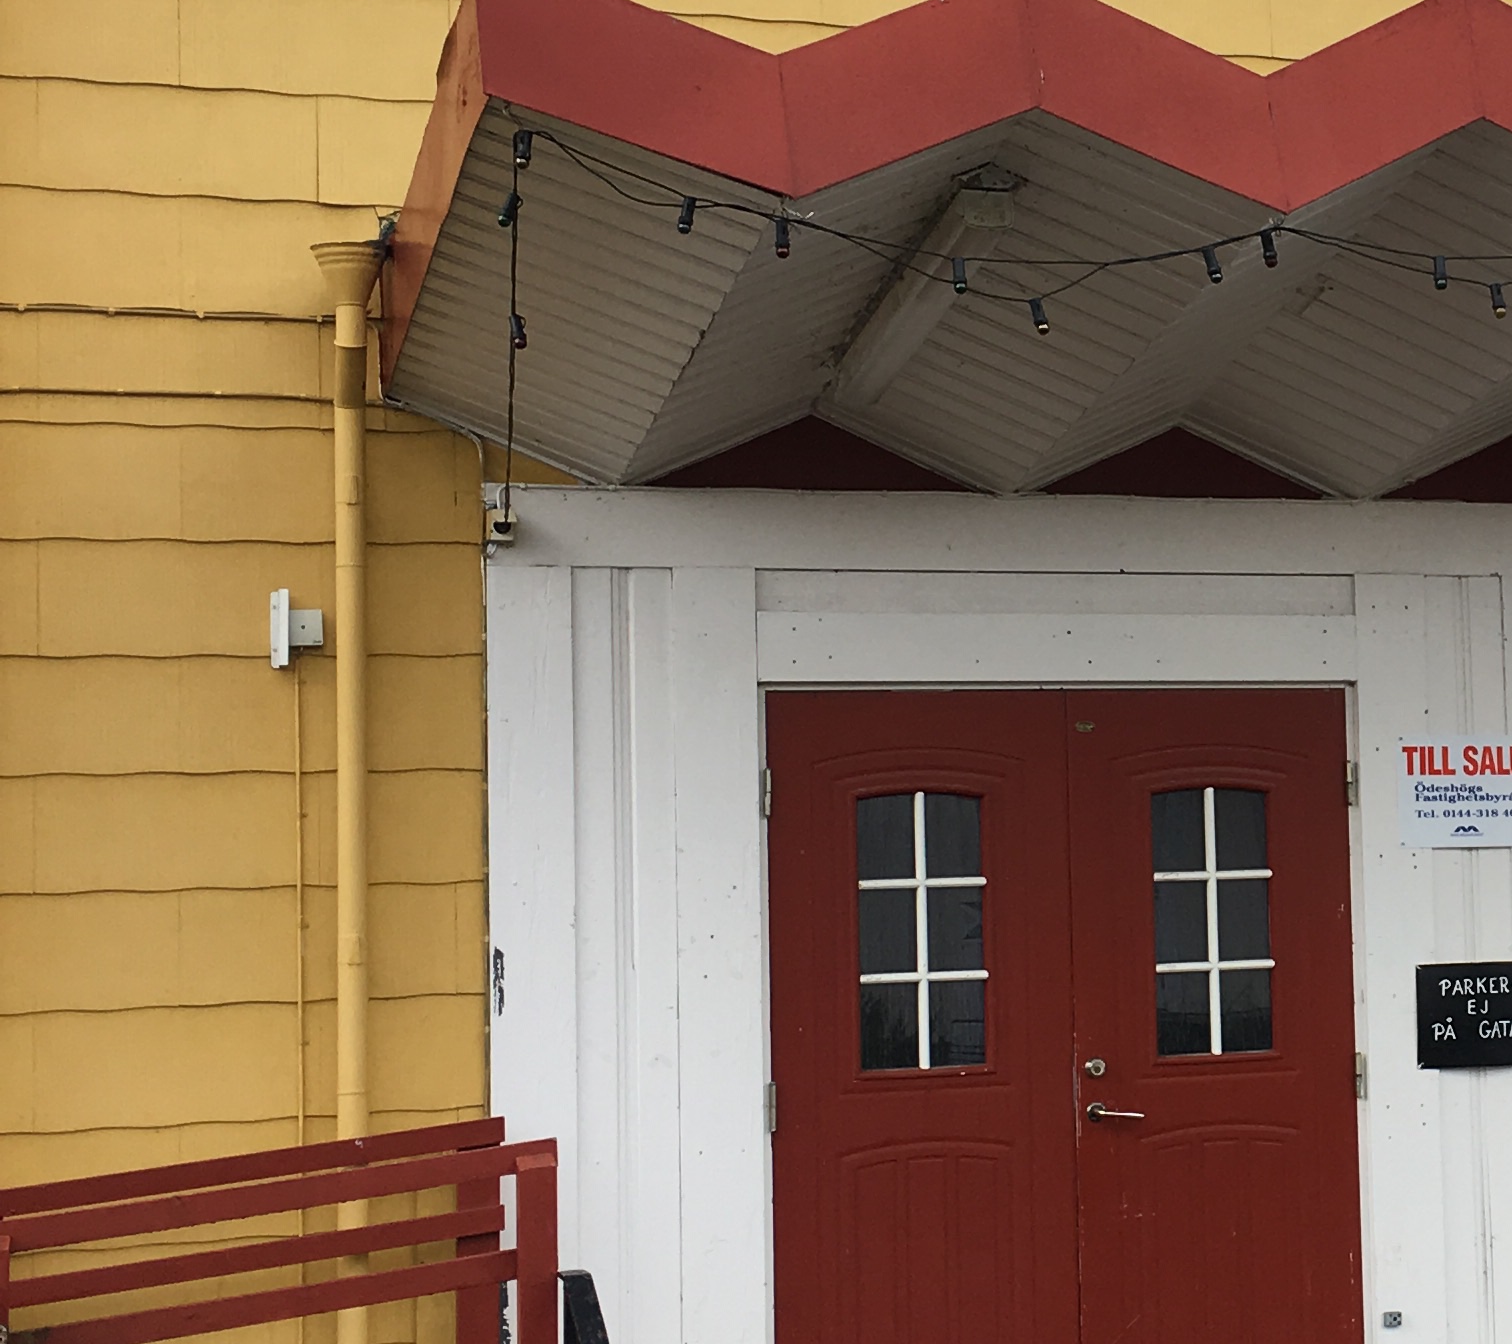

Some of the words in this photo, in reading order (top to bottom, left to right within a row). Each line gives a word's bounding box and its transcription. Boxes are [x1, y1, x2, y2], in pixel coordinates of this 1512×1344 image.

[1402, 746, 1457, 776] TILL
[1414, 781, 1483, 794] Ödeshögs
[1415, 809, 1440, 818] Tel.
[1442, 809, 1499, 818] 0144-318
[1466, 998, 1489, 1015] EJ
[1431, 1016, 1457, 1041] PÅ
